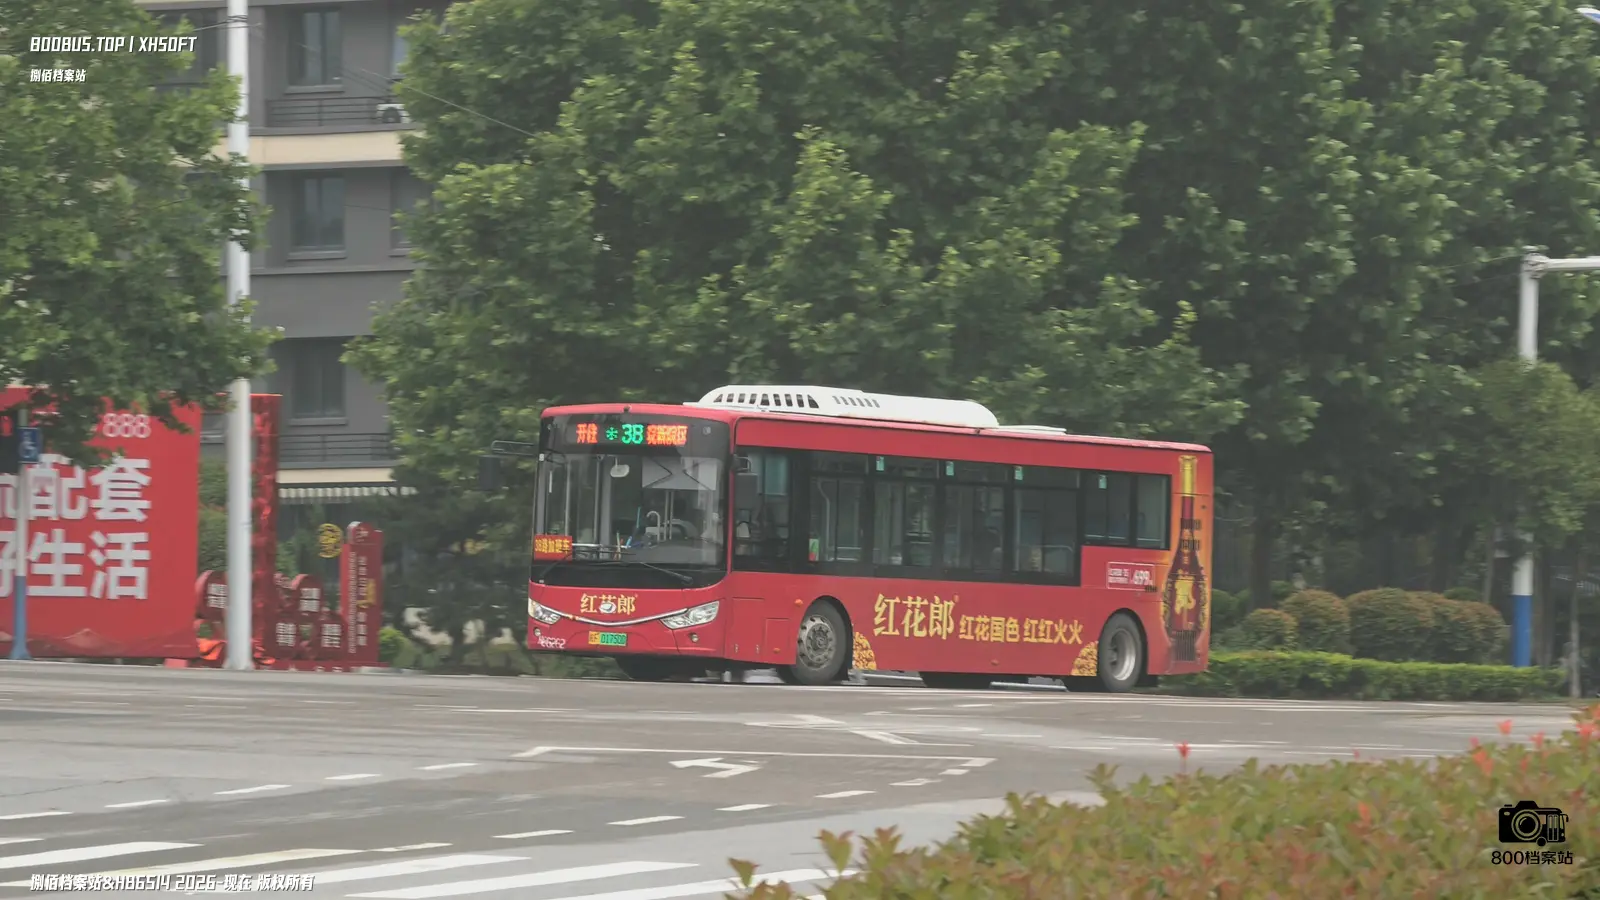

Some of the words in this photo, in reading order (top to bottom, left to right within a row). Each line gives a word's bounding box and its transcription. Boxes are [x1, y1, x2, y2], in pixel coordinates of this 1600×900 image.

[873, 594, 956, 640] 红花郎
[959, 614, 1021, 643] 红花国色
[1023, 617, 1084, 645] 红红火火
